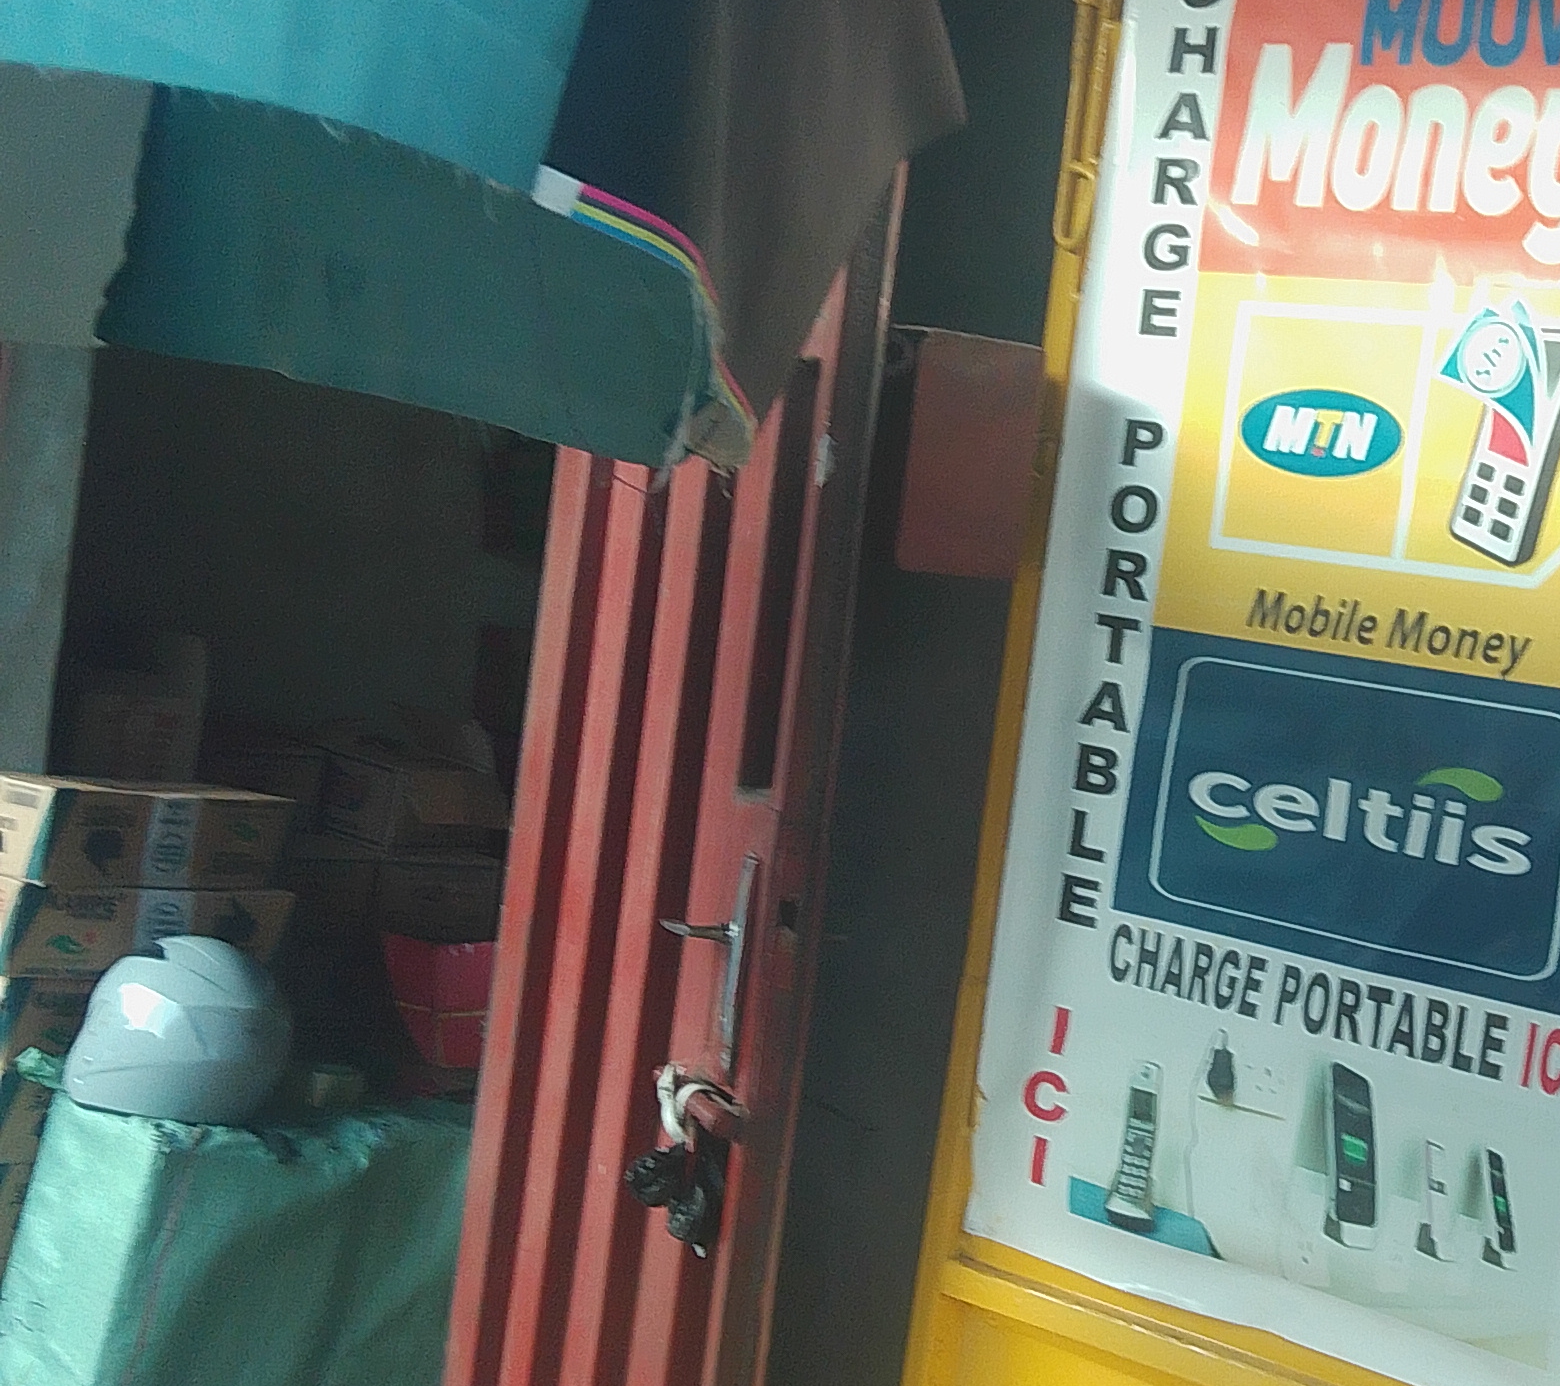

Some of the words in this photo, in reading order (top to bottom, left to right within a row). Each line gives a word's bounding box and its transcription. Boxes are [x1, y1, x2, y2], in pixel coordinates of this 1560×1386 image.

[1262, 403, 1379, 463] MTN
[1055, 416, 1165, 931] PORTABLE
[1245, 587, 1378, 645] Mobile
[1385, 608, 1534, 678] Money
[1186, 769, 1533, 877] celtiis
[1108, 922, 1268, 1013] CHARGE
[1274, 964, 1511, 1080] PORTABLE
[1022, 1006, 1073, 1187] ICI
